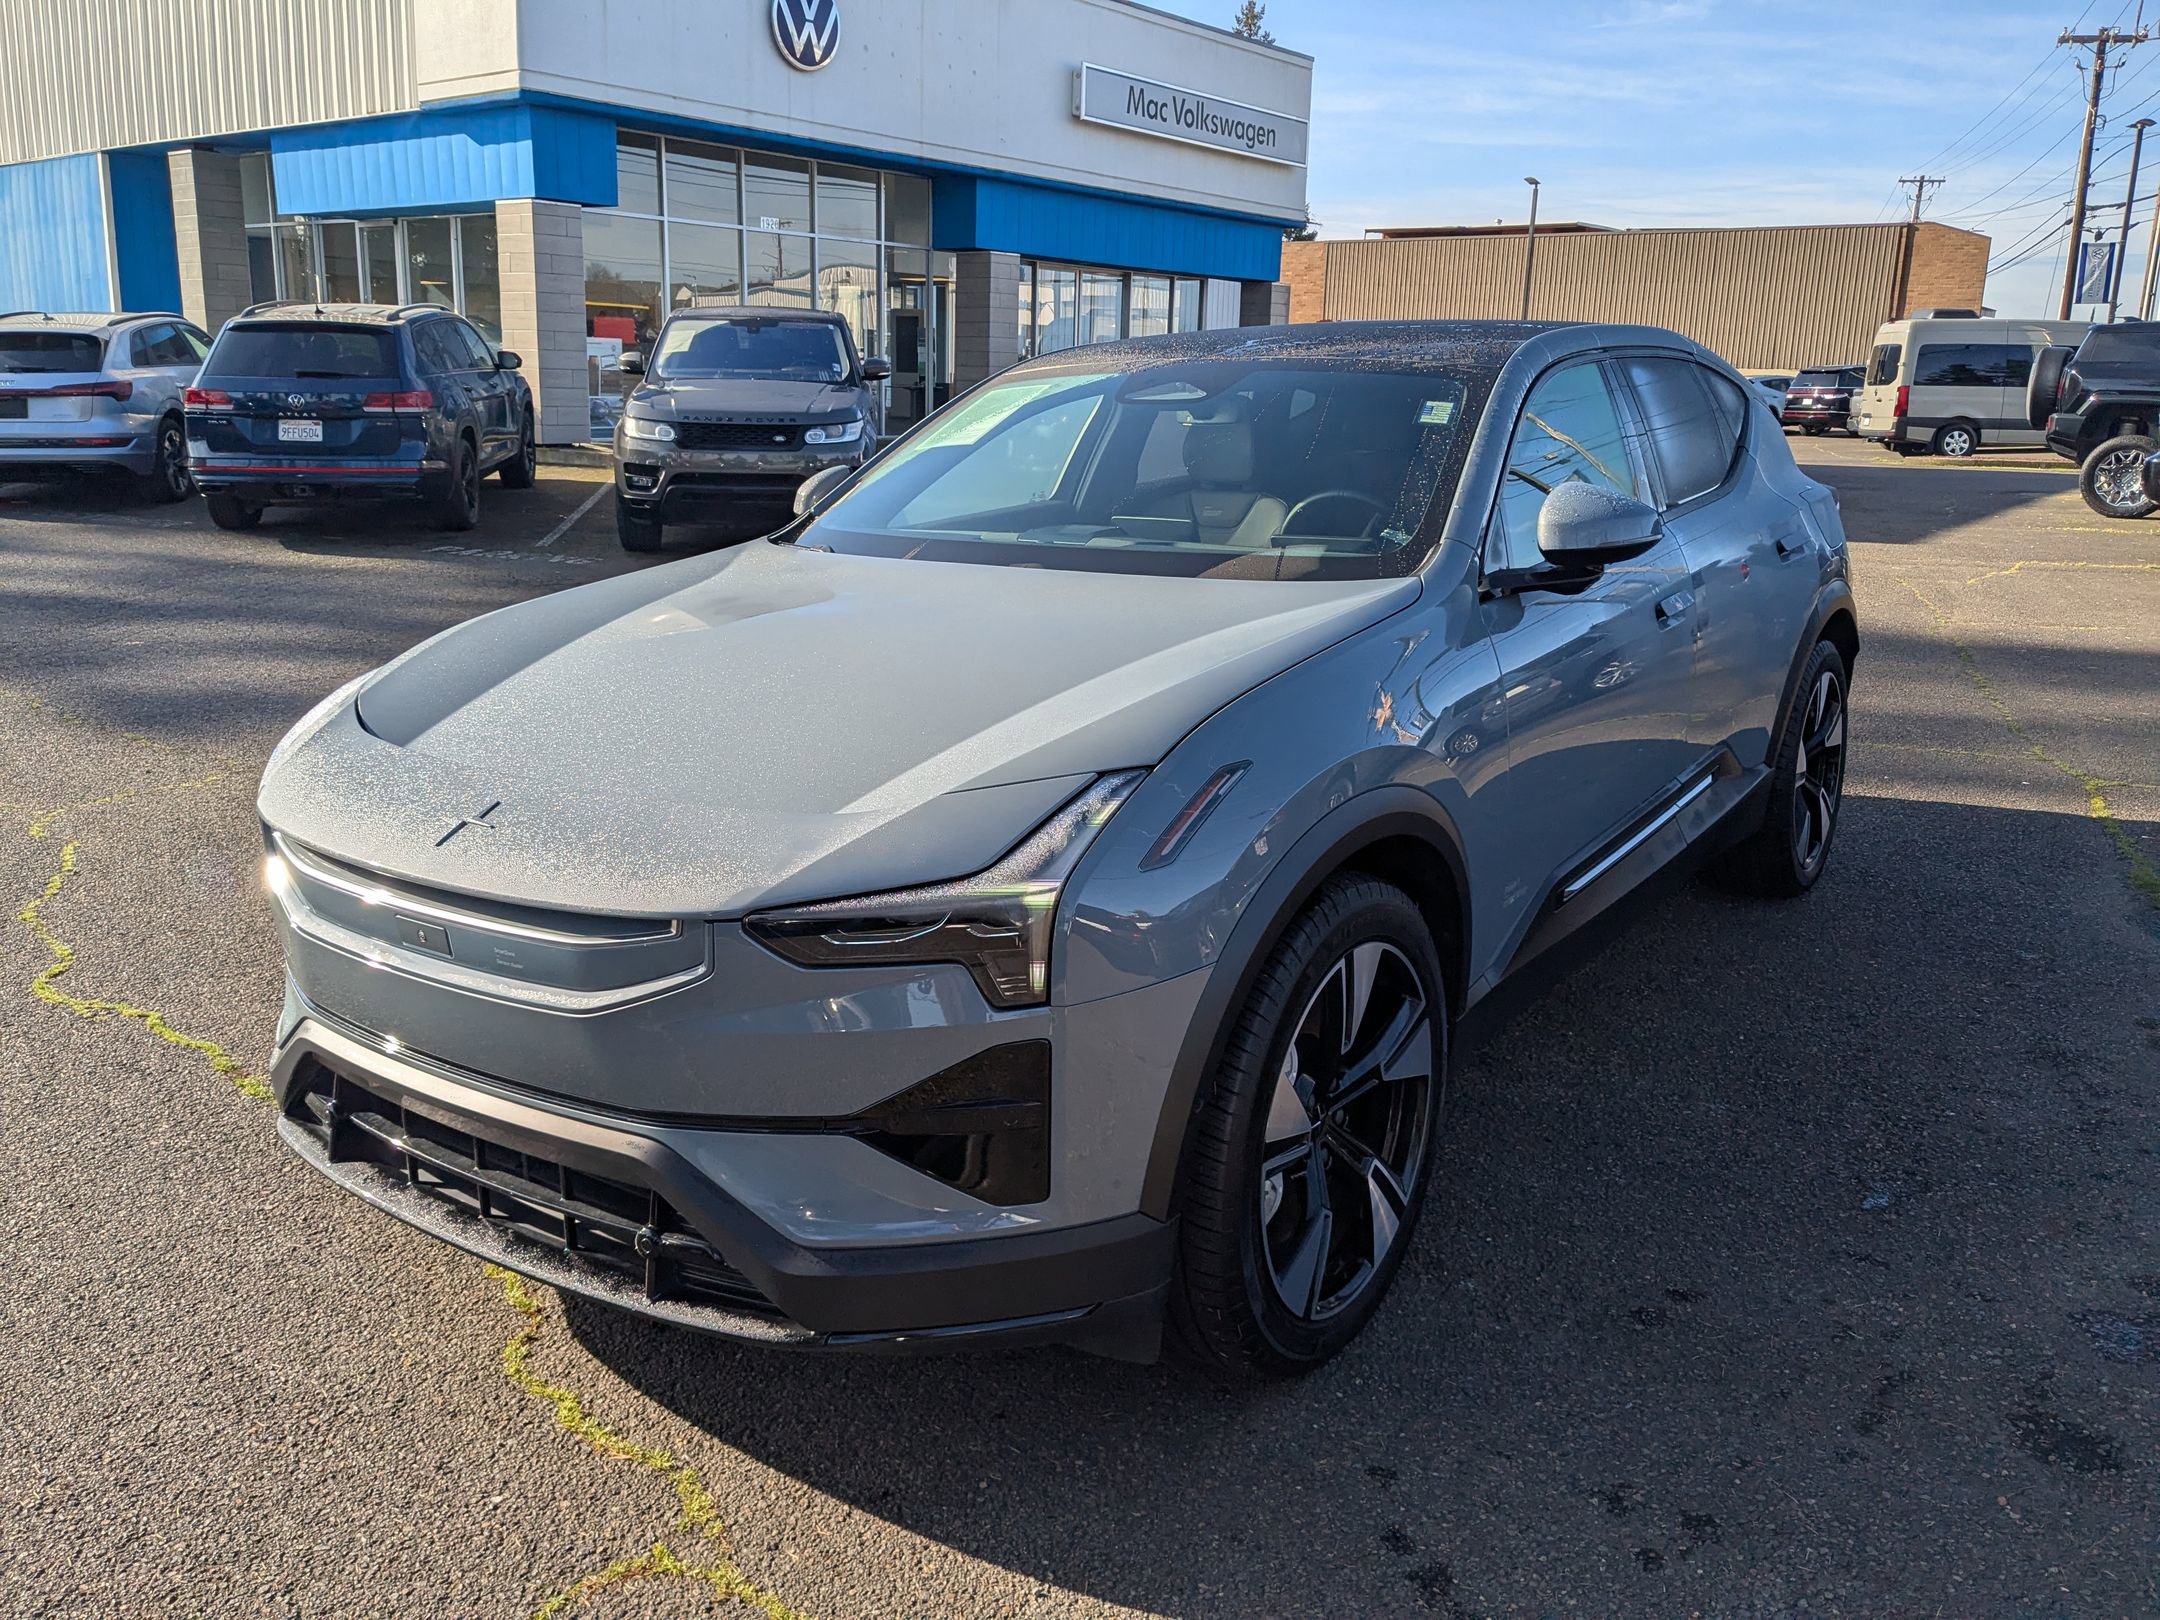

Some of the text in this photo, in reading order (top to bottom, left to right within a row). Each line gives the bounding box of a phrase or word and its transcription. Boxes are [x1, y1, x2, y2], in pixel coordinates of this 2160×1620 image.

[775, 0, 838, 65] VW
[1126, 85, 1276, 148] Mac Volkswagen
